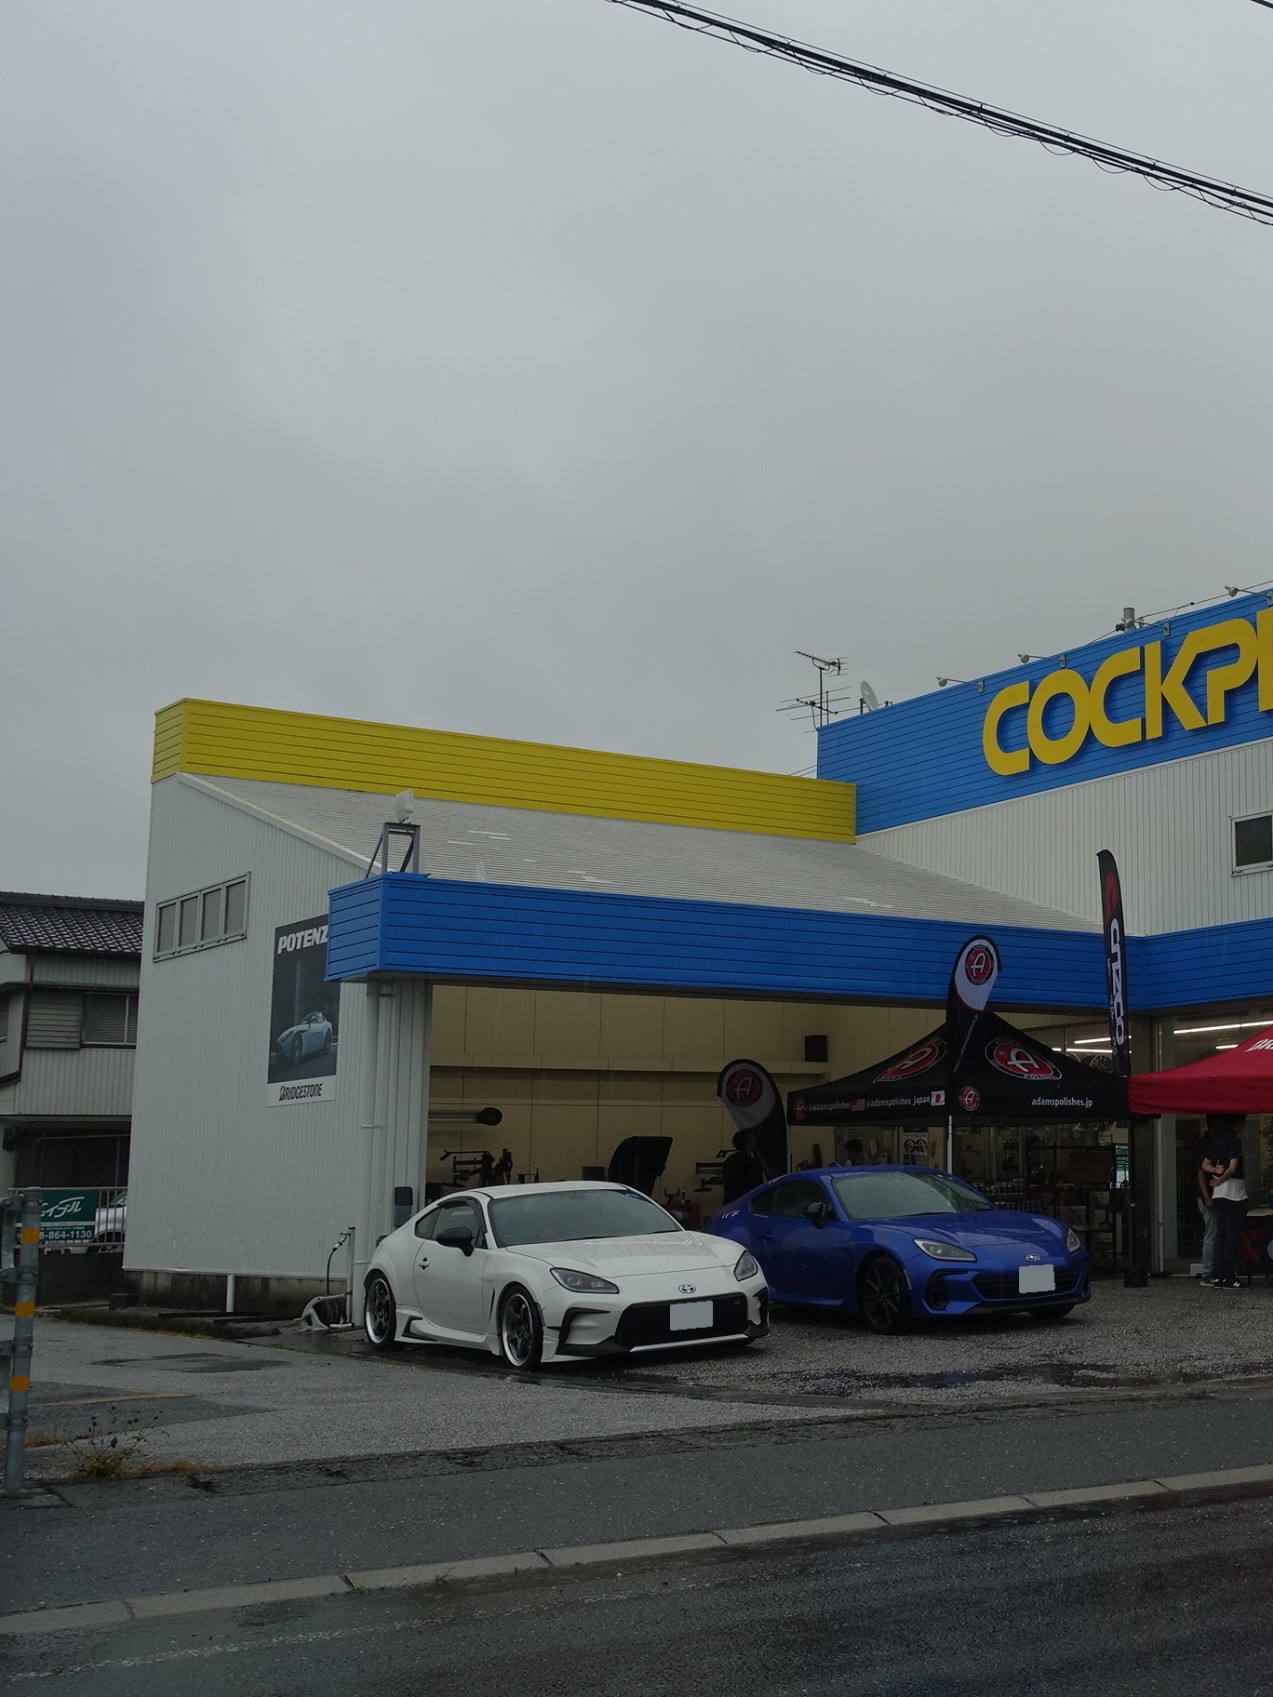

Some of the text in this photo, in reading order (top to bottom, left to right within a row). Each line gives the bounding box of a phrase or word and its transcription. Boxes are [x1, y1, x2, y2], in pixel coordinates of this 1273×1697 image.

[277, 924, 330, 955] POTENZ
[278, 1083, 324, 1101] BRIDGESTONE
[1031, 1097, 1093, 1108] adamspolishes.jp
